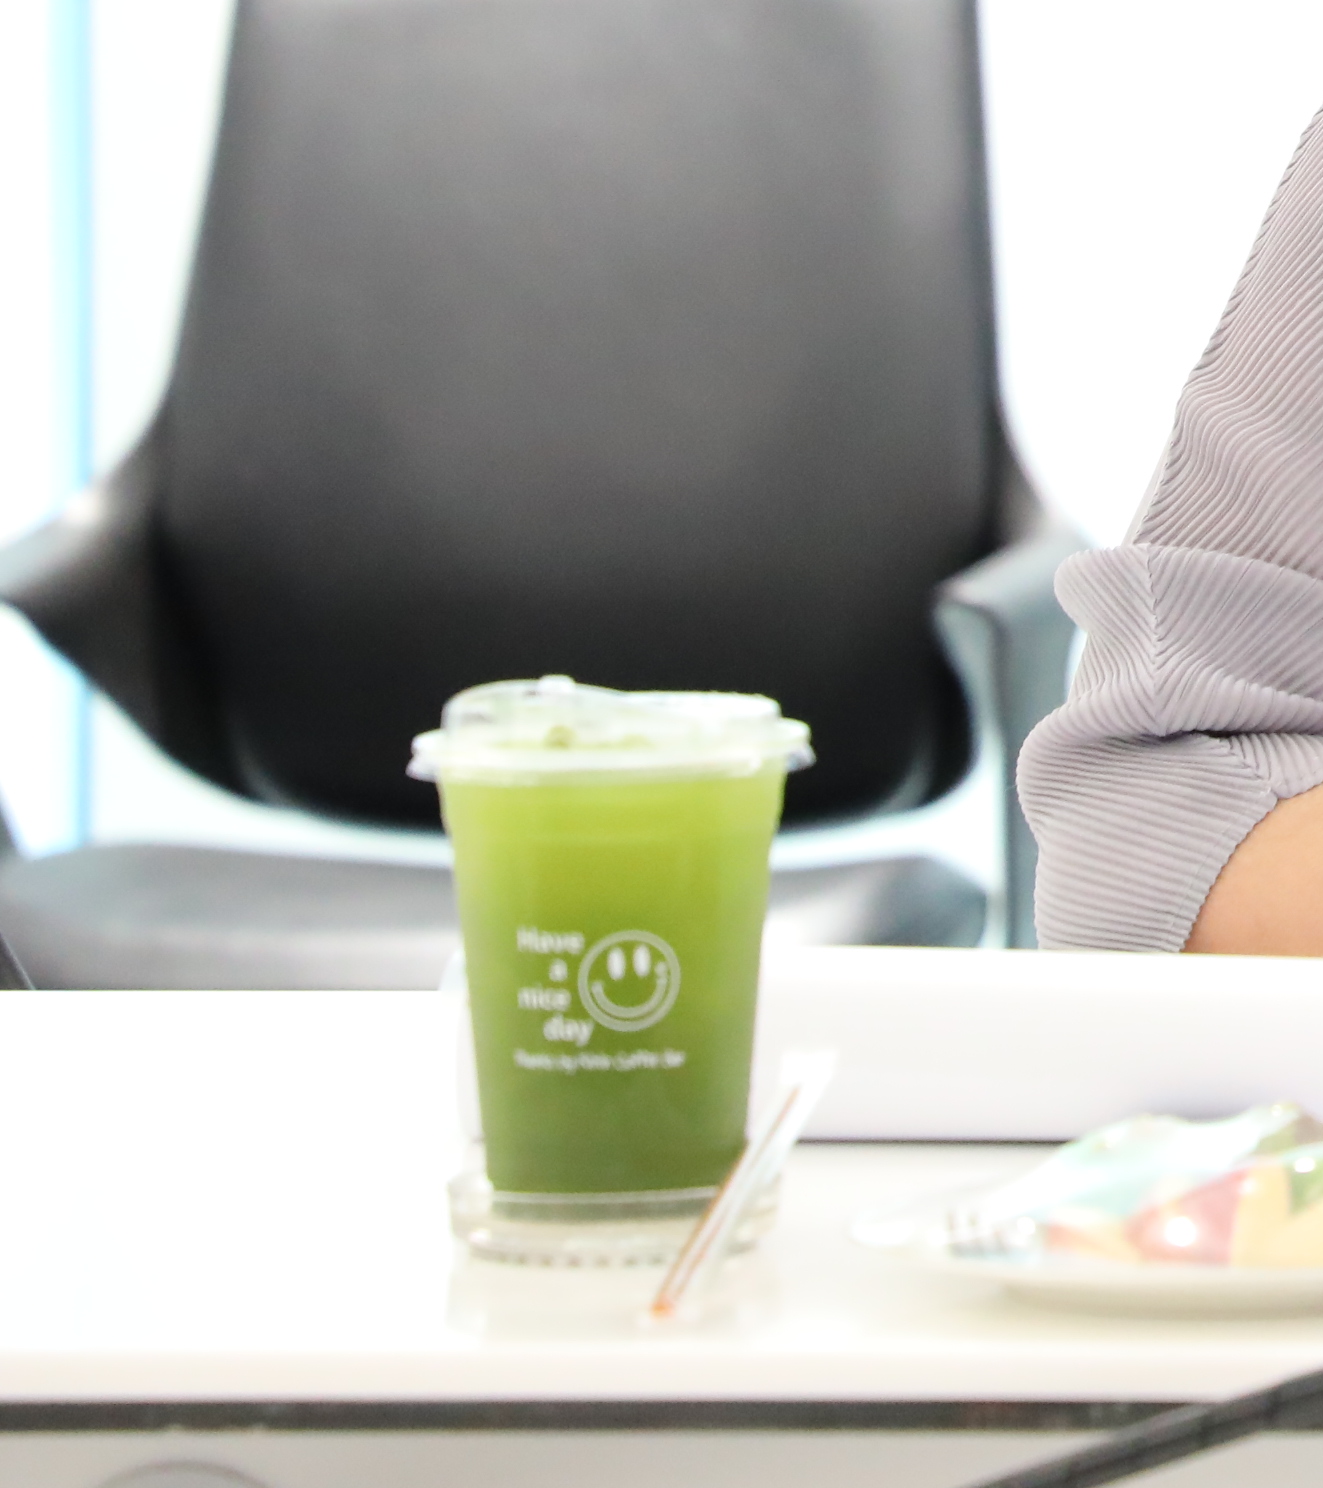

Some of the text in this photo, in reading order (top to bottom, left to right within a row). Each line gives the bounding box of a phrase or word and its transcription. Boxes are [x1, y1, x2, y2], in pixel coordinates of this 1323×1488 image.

[516, 927, 584, 954] Have
[550, 959, 568, 981] a
[517, 985, 571, 1010] nice
[543, 1014, 593, 1046] day
